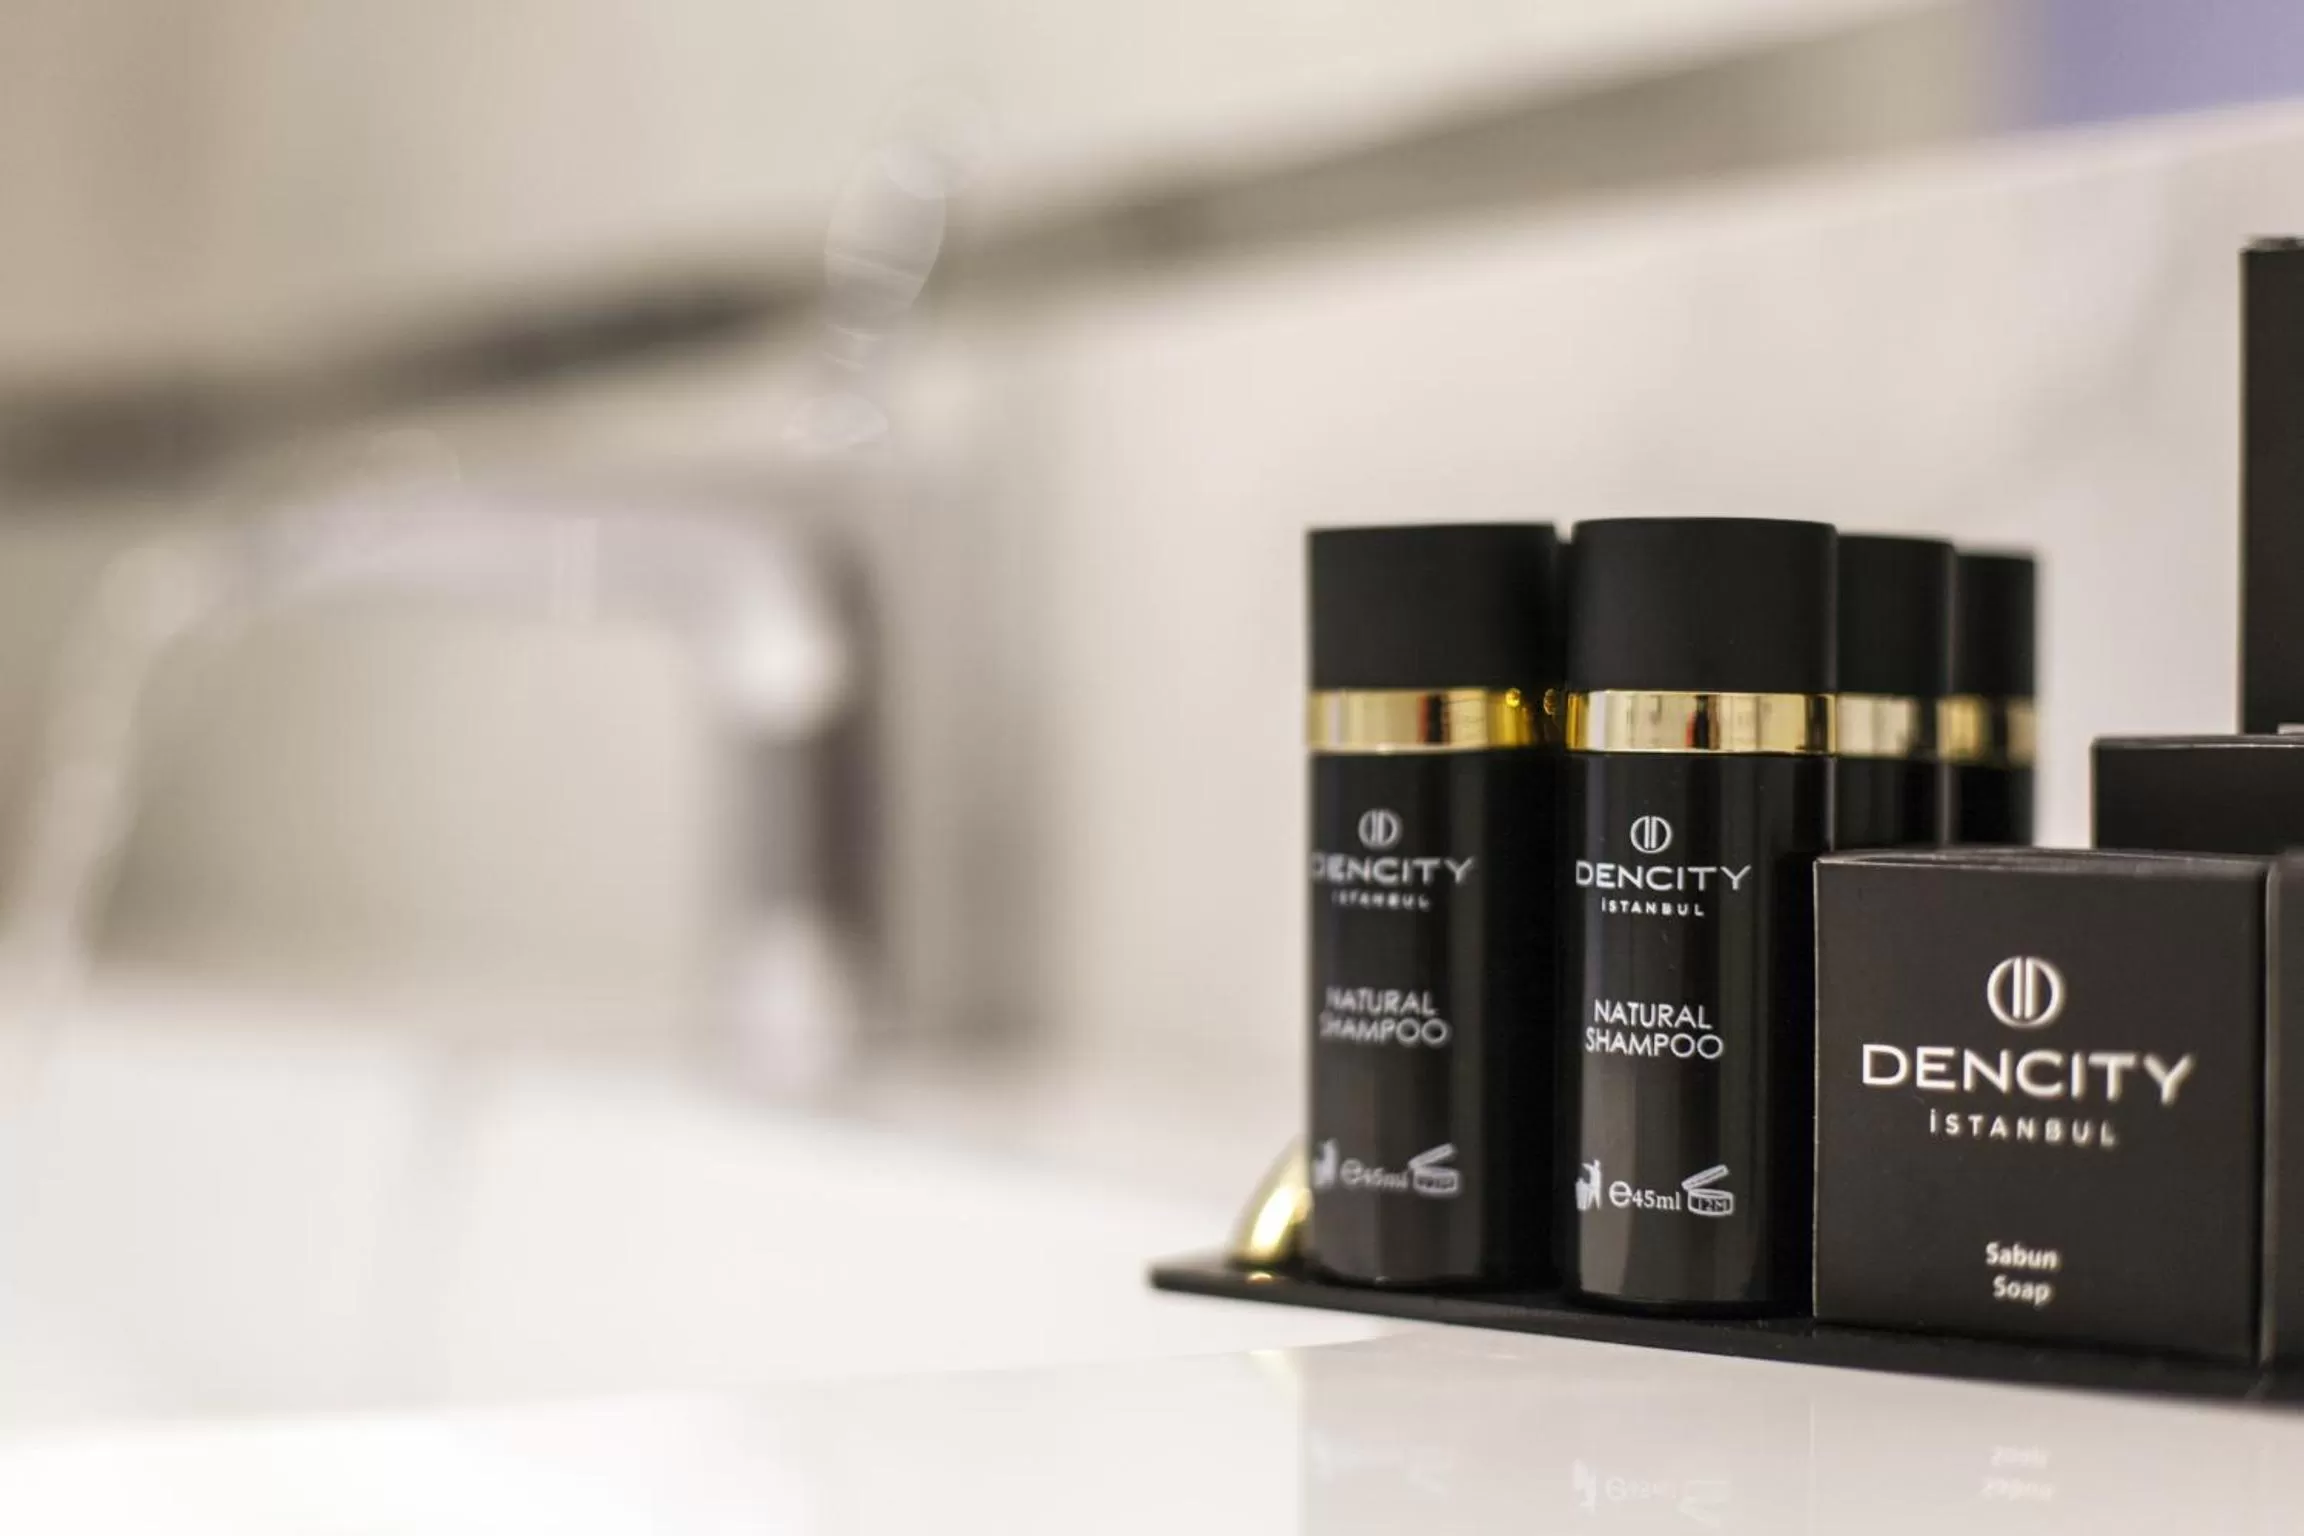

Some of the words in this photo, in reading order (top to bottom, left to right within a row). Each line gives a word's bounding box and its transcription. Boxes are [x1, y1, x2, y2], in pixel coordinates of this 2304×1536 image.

[1575, 860, 1752, 891] DENCITY
[1325, 986, 1439, 1017] NATURAL
[1594, 999, 1713, 1030] NATURAL
[1585, 1026, 1724, 1060] SHAMPOO
[1862, 1044, 2195, 1106] DENCITY
[1985, 1241, 2061, 1270] Sabun
[1992, 1273, 2055, 1310] Soap
